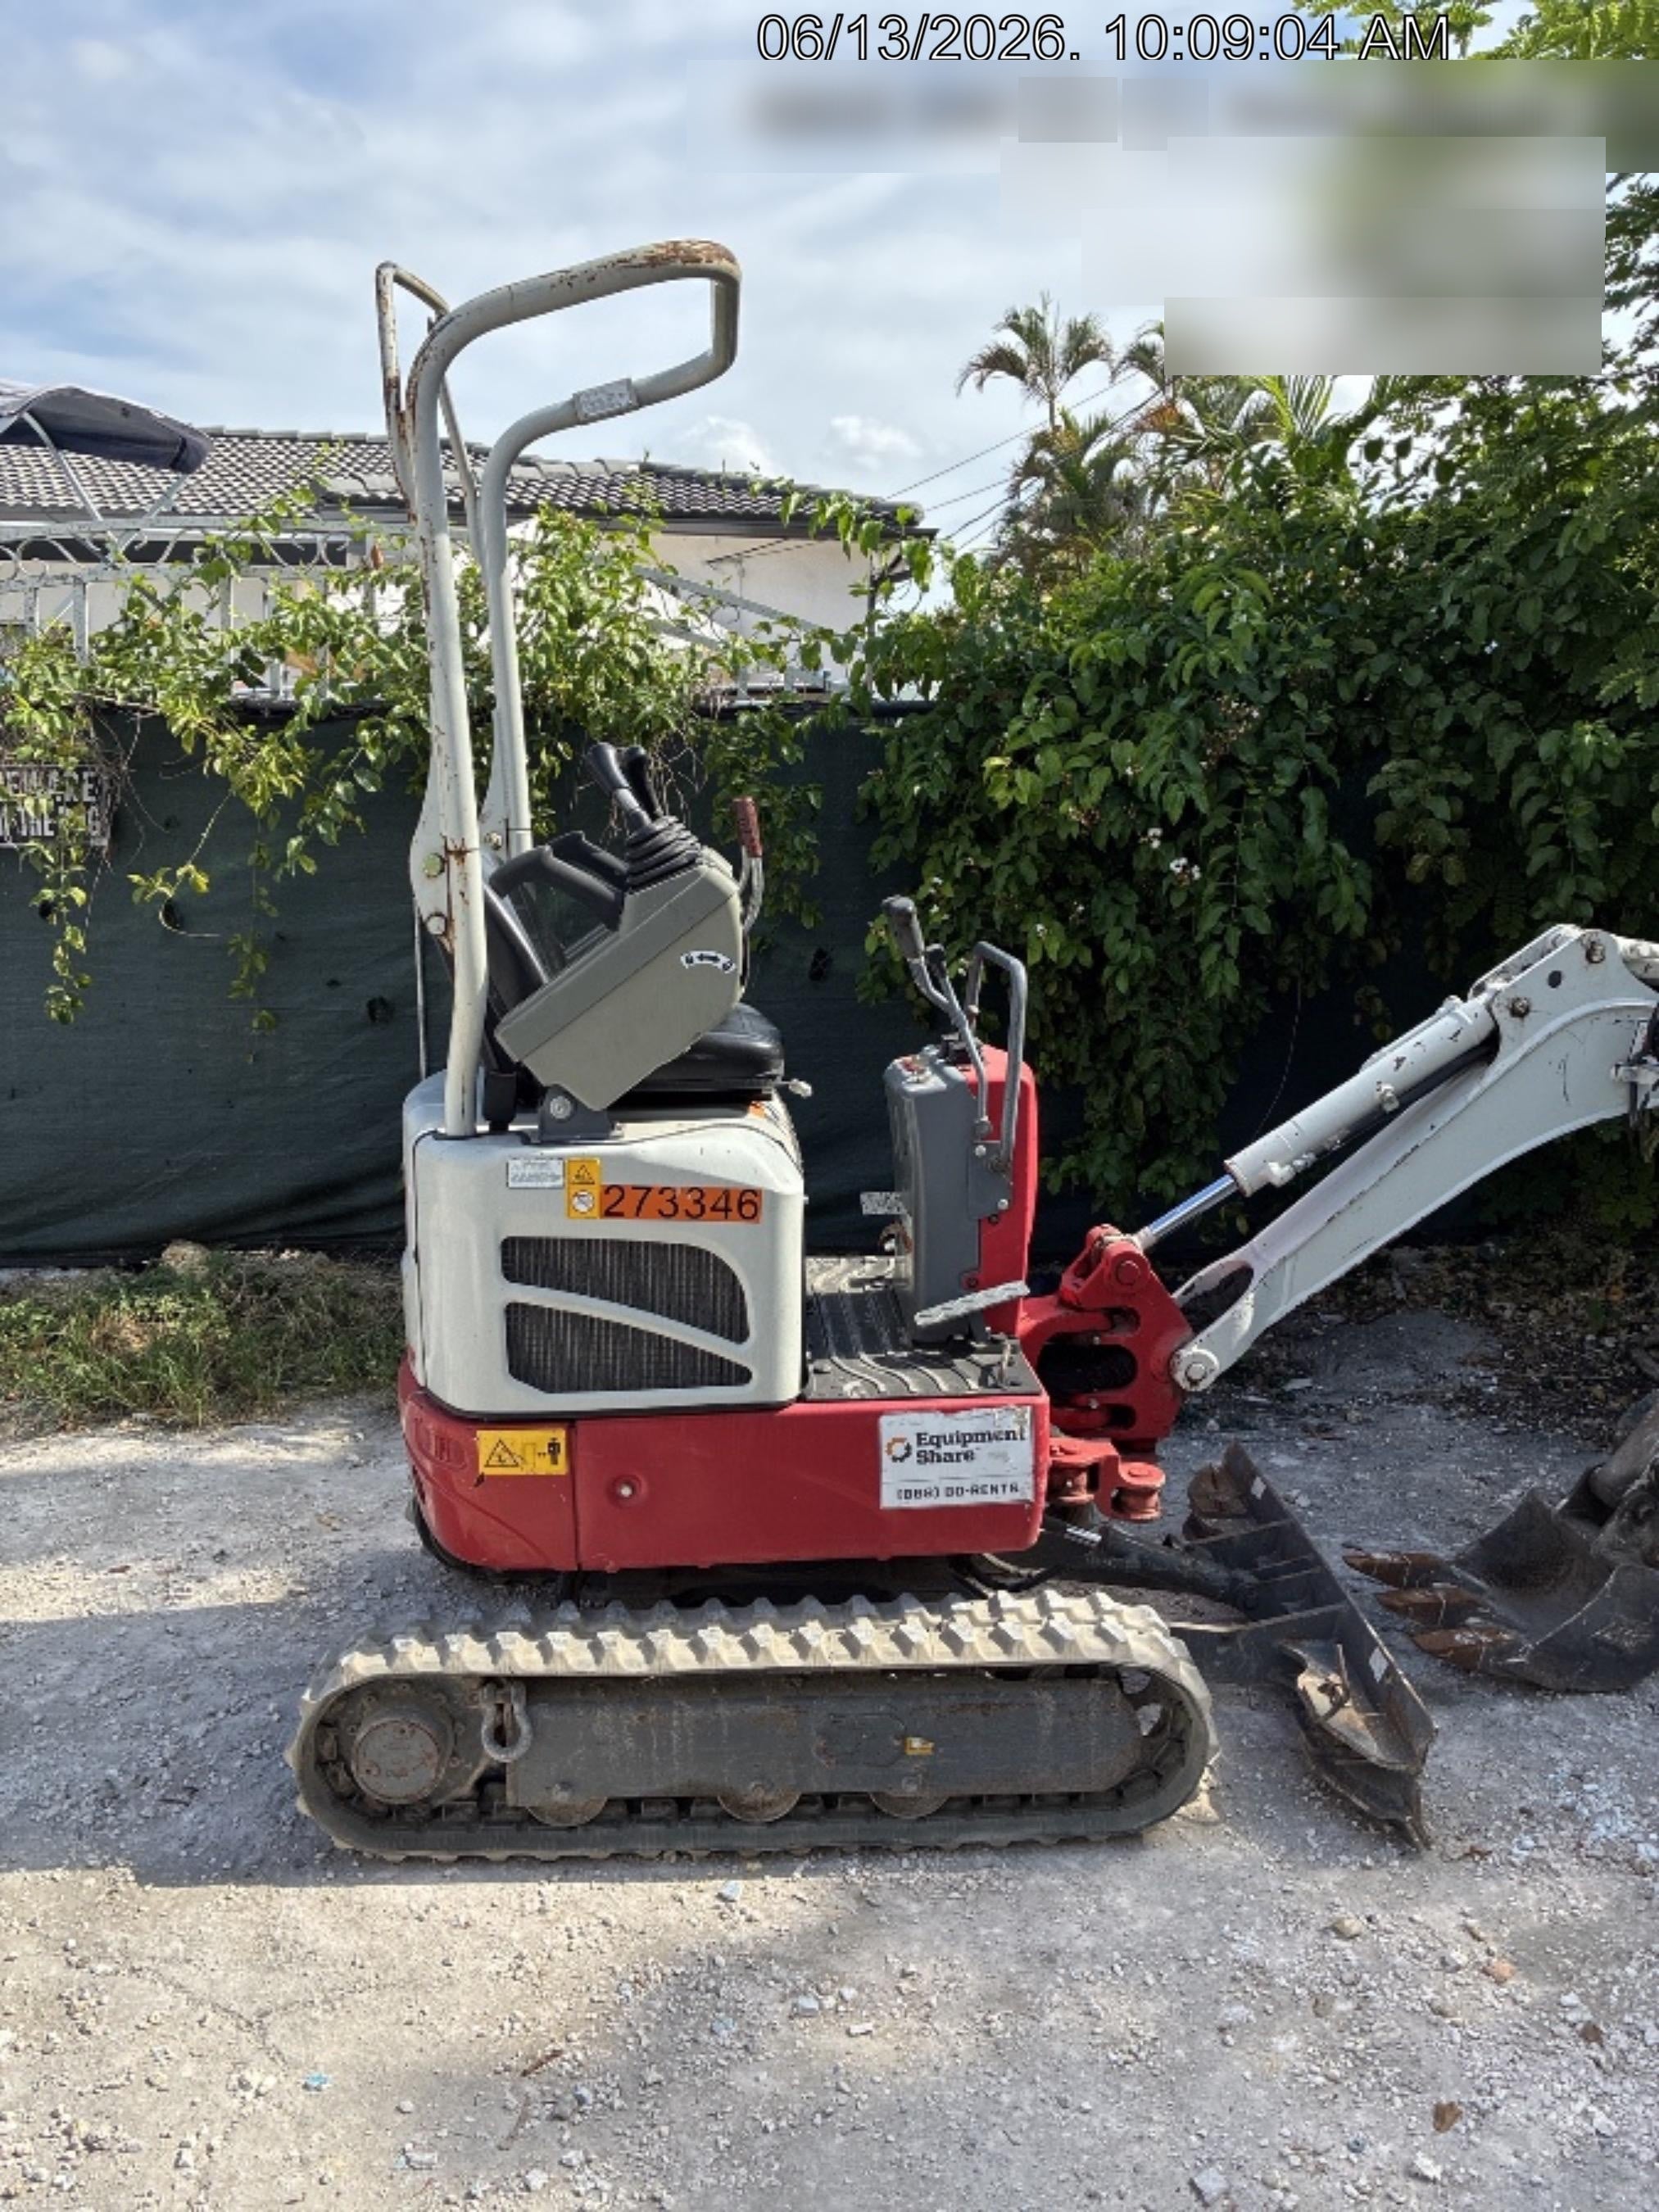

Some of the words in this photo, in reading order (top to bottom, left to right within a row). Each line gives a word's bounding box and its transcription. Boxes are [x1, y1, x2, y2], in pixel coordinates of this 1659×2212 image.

[603, 1185, 761, 1221] 273346
[915, 1430, 1026, 1448] Equipment
[915, 1449, 975, 1466] Share
